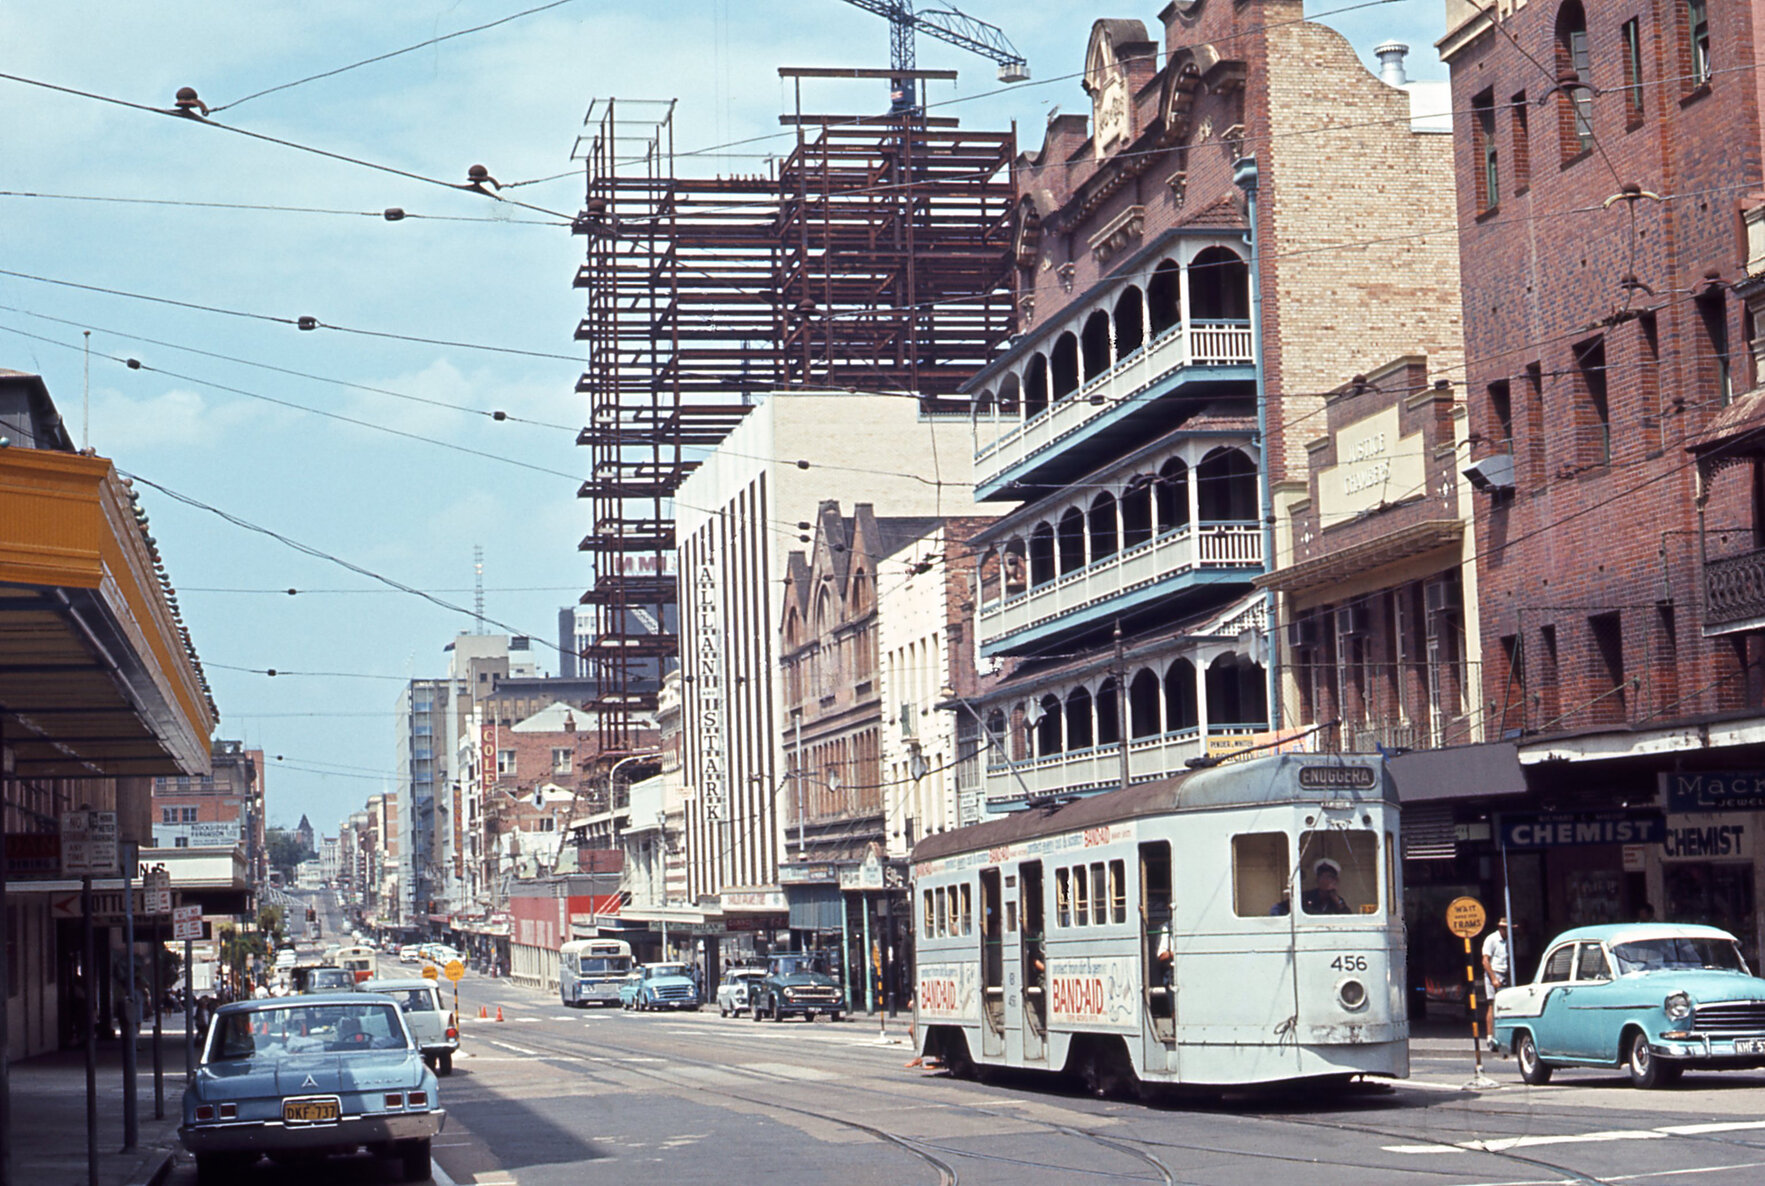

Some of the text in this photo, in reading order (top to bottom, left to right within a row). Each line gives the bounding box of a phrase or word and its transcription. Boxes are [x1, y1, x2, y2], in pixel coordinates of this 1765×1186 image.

[1349, 433, 1385, 464] JUSTICE
[700, 567, 715, 675] ALLAN
[703, 711, 719, 820] STARK
[1511, 820, 1654, 845] CHEMIST
[1664, 825, 1744, 857] CHEMIST
[1331, 955, 1368, 971] 456
[922, 980, 956, 1009] BAND-AID
[1053, 979, 1103, 1014] BAND-AID
